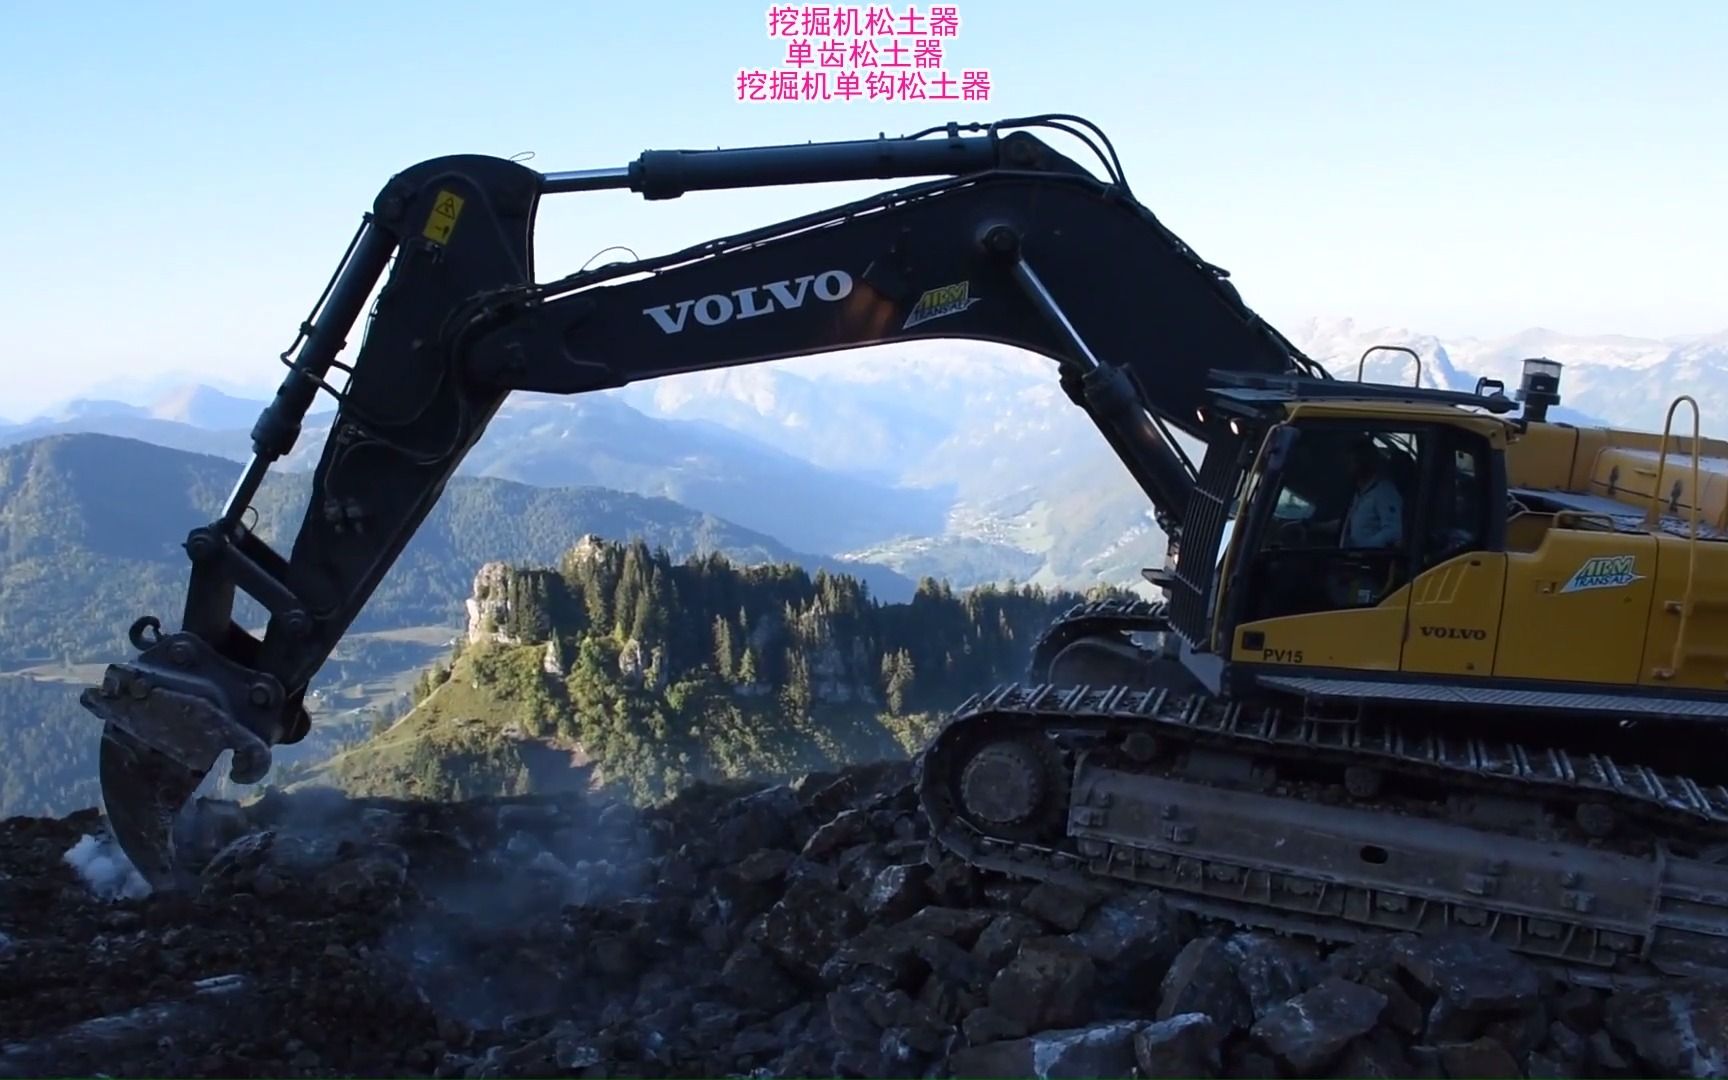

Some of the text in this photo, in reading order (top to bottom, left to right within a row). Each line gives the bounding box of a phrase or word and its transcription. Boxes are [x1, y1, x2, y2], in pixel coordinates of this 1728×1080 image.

[643, 270, 853, 335] VOLVO
[1420, 626, 1487, 640] VOLVO
[1263, 649, 1303, 663] PV15
